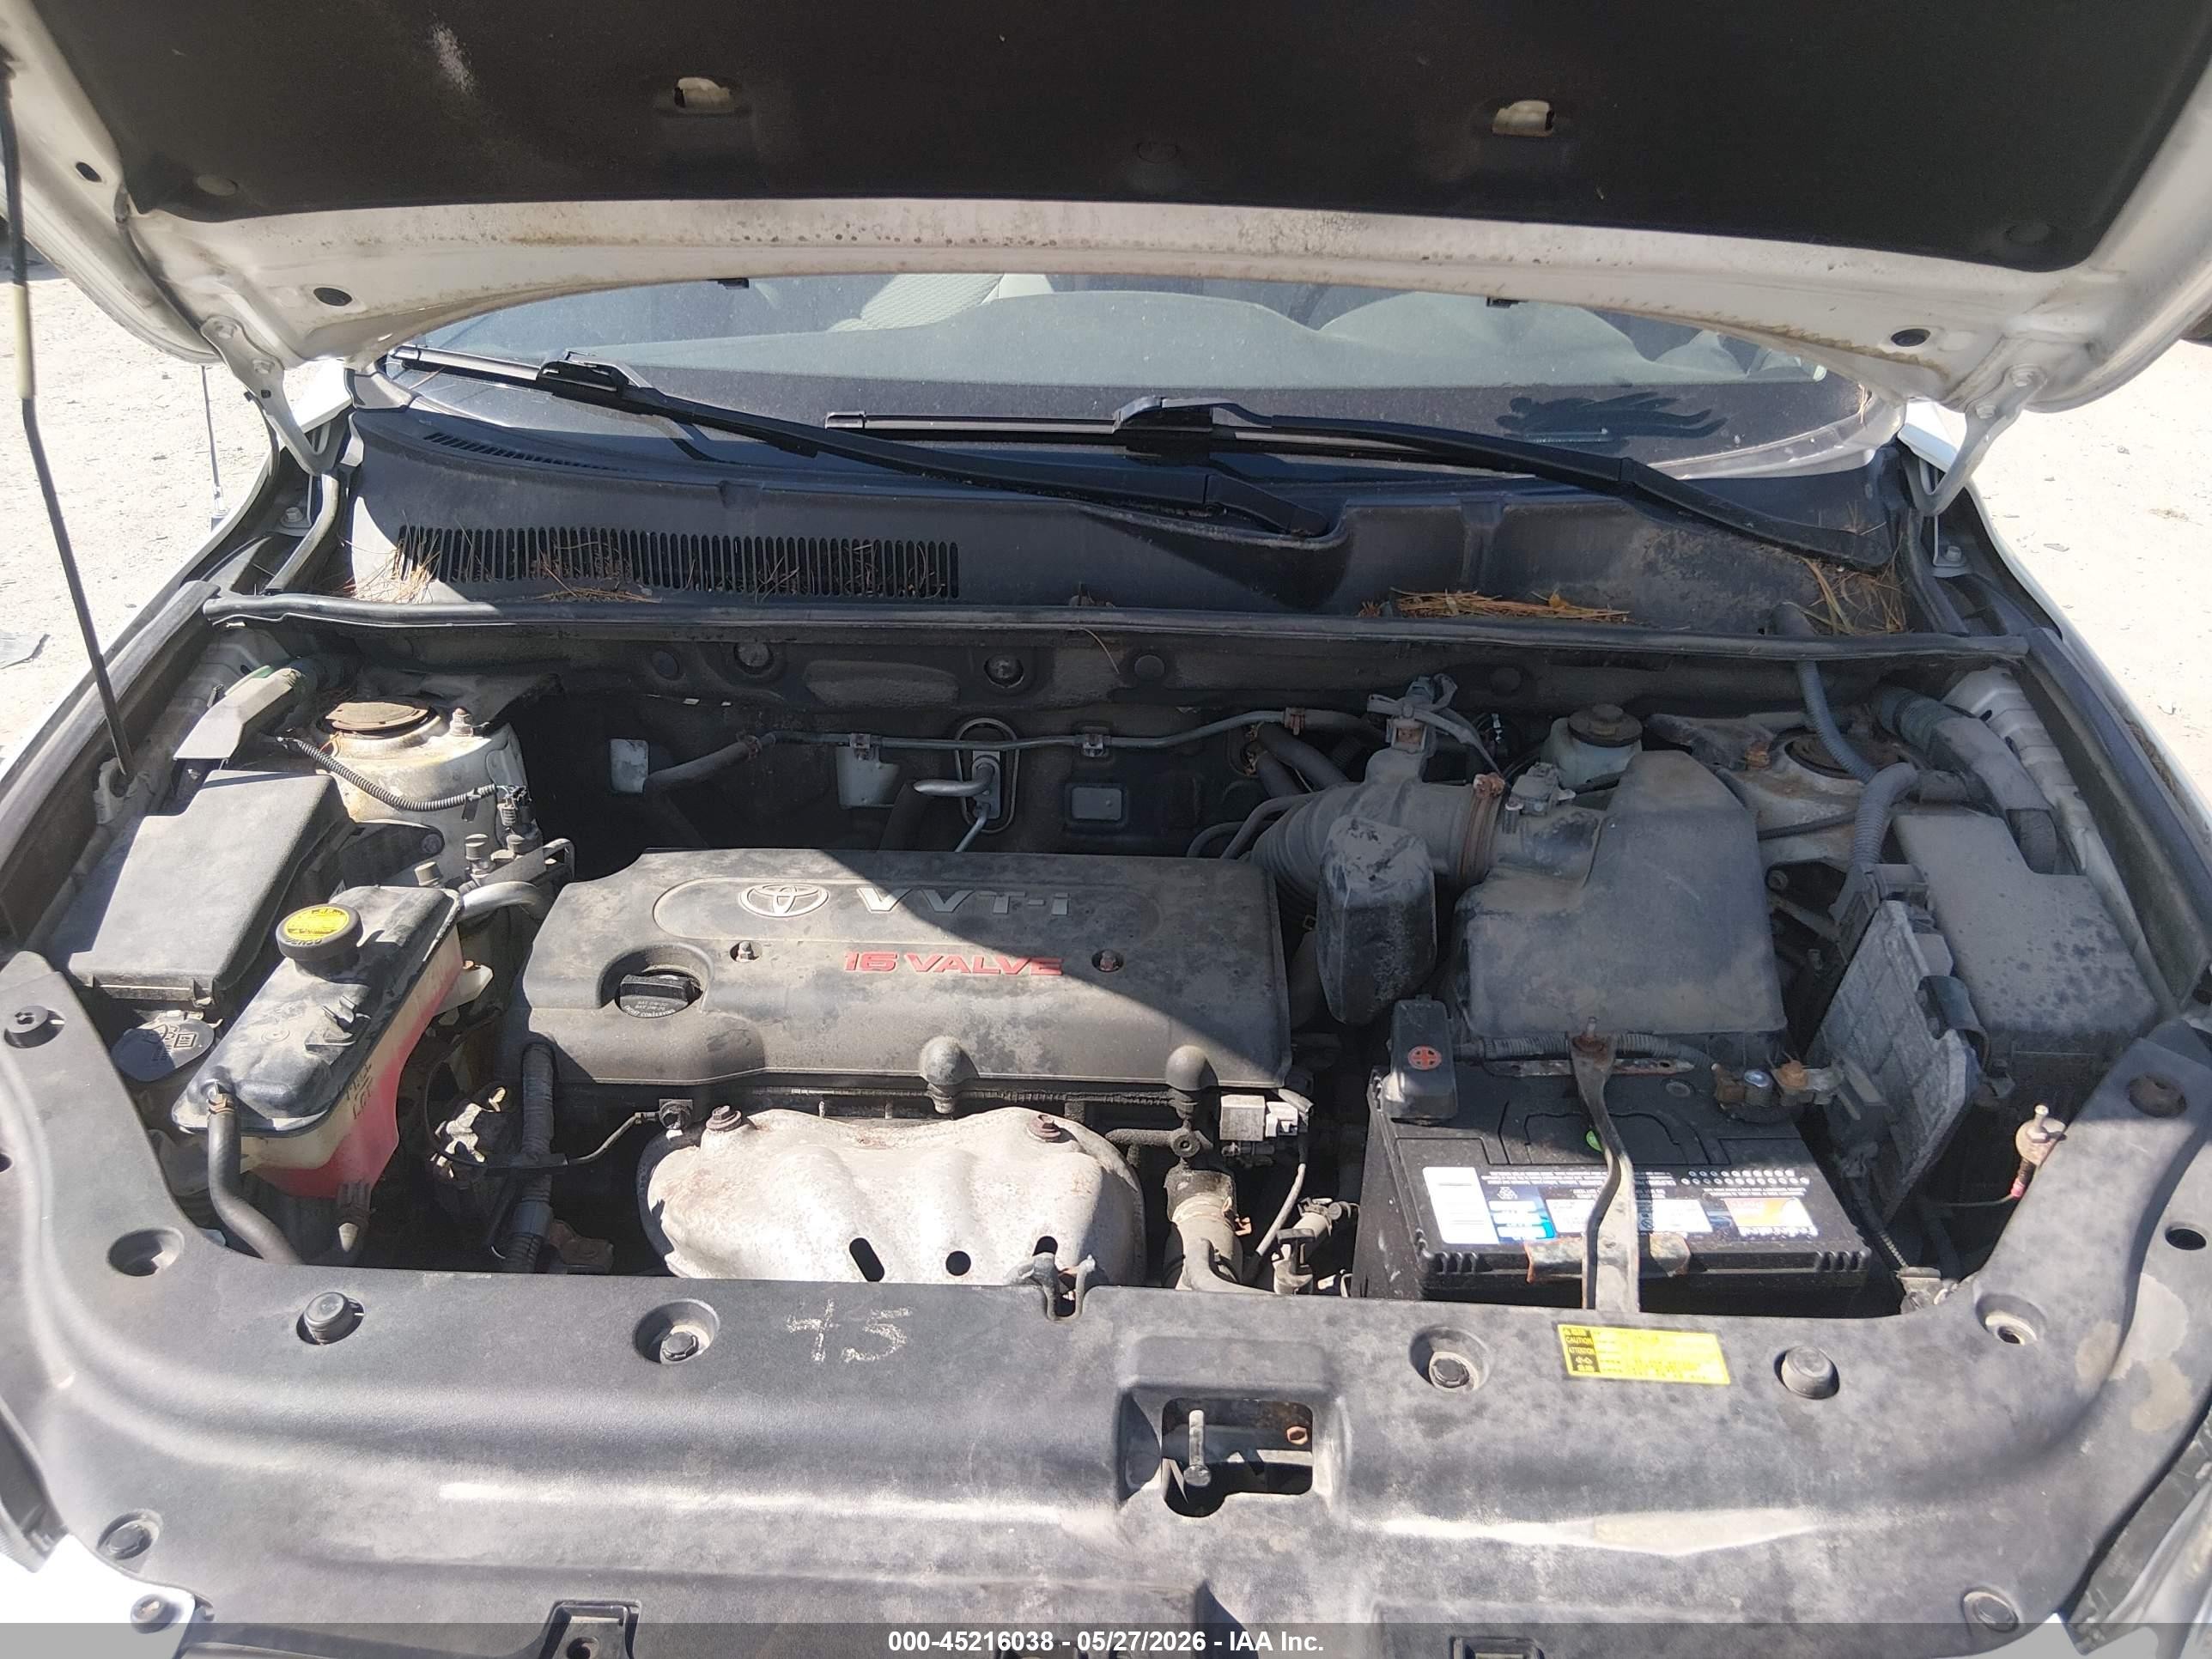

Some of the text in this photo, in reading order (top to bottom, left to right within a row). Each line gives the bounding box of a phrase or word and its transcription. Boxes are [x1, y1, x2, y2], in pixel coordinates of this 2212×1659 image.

[856, 886, 1072, 915] VVT-i
[843, 951, 1064, 975] 16 VALVE
[1565, 1336, 1594, 1345] CAUTION
